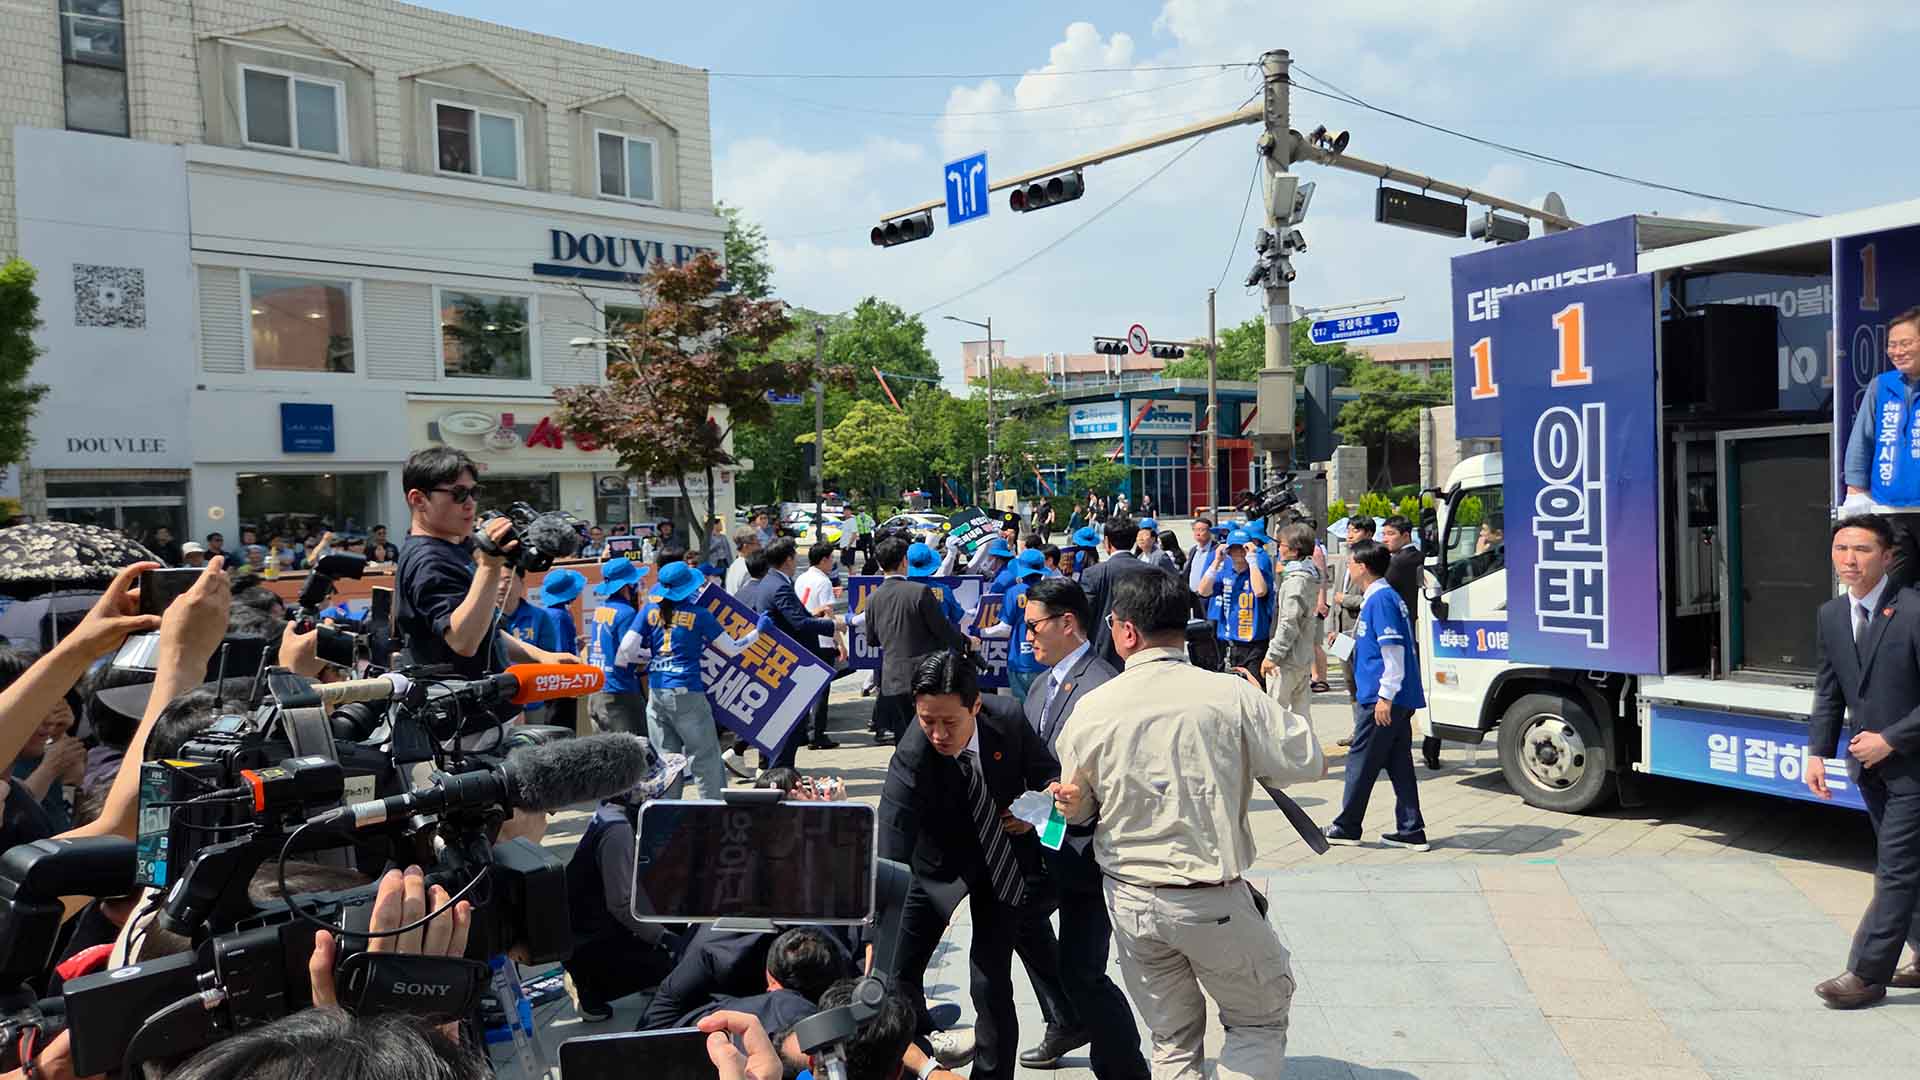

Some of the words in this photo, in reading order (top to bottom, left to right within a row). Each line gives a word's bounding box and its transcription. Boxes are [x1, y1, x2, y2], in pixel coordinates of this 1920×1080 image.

[549, 229, 716, 271] DOUVLE
[1552, 302, 1593, 387] 1
[1470, 336, 1499, 400] 1
[66, 438, 167, 453] DOUVLEE
[1533, 402, 1609, 650] 이원택
[624, 551, 641, 561] OUT
[647, 608, 696, 631] 이택
[1476, 628, 1488, 652] 1
[535, 674, 598, 692] 연합뉴스TV
[755, 663, 832, 751] 1
[1707, 733, 1738, 773] 일
[391, 982, 451, 997] SONY
